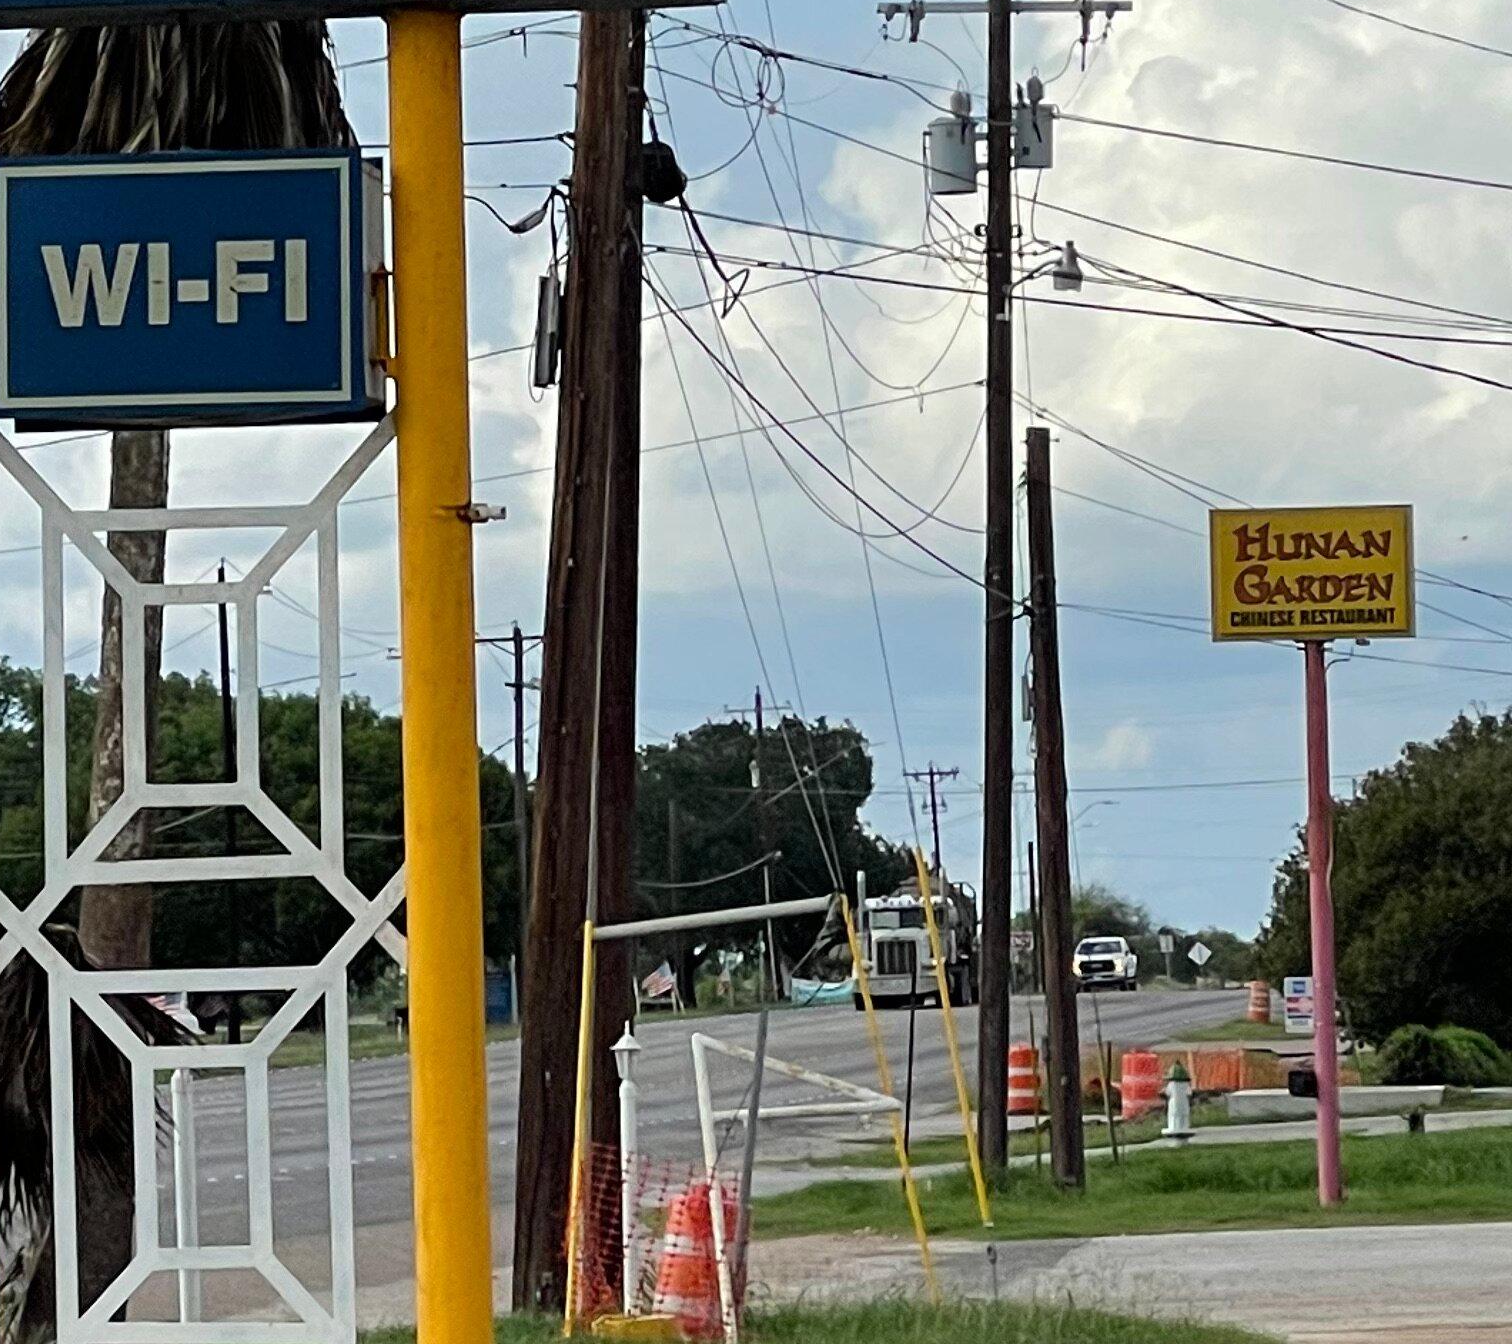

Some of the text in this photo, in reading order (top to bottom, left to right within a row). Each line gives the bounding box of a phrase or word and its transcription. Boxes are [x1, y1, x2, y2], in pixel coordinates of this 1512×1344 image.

[40, 239, 308, 328] WI-FI
[1232, 522, 1391, 562] HUNAN
[1233, 564, 1394, 605] GARDEN
[1230, 608, 1395, 626] CHINESE RESTAURANT
